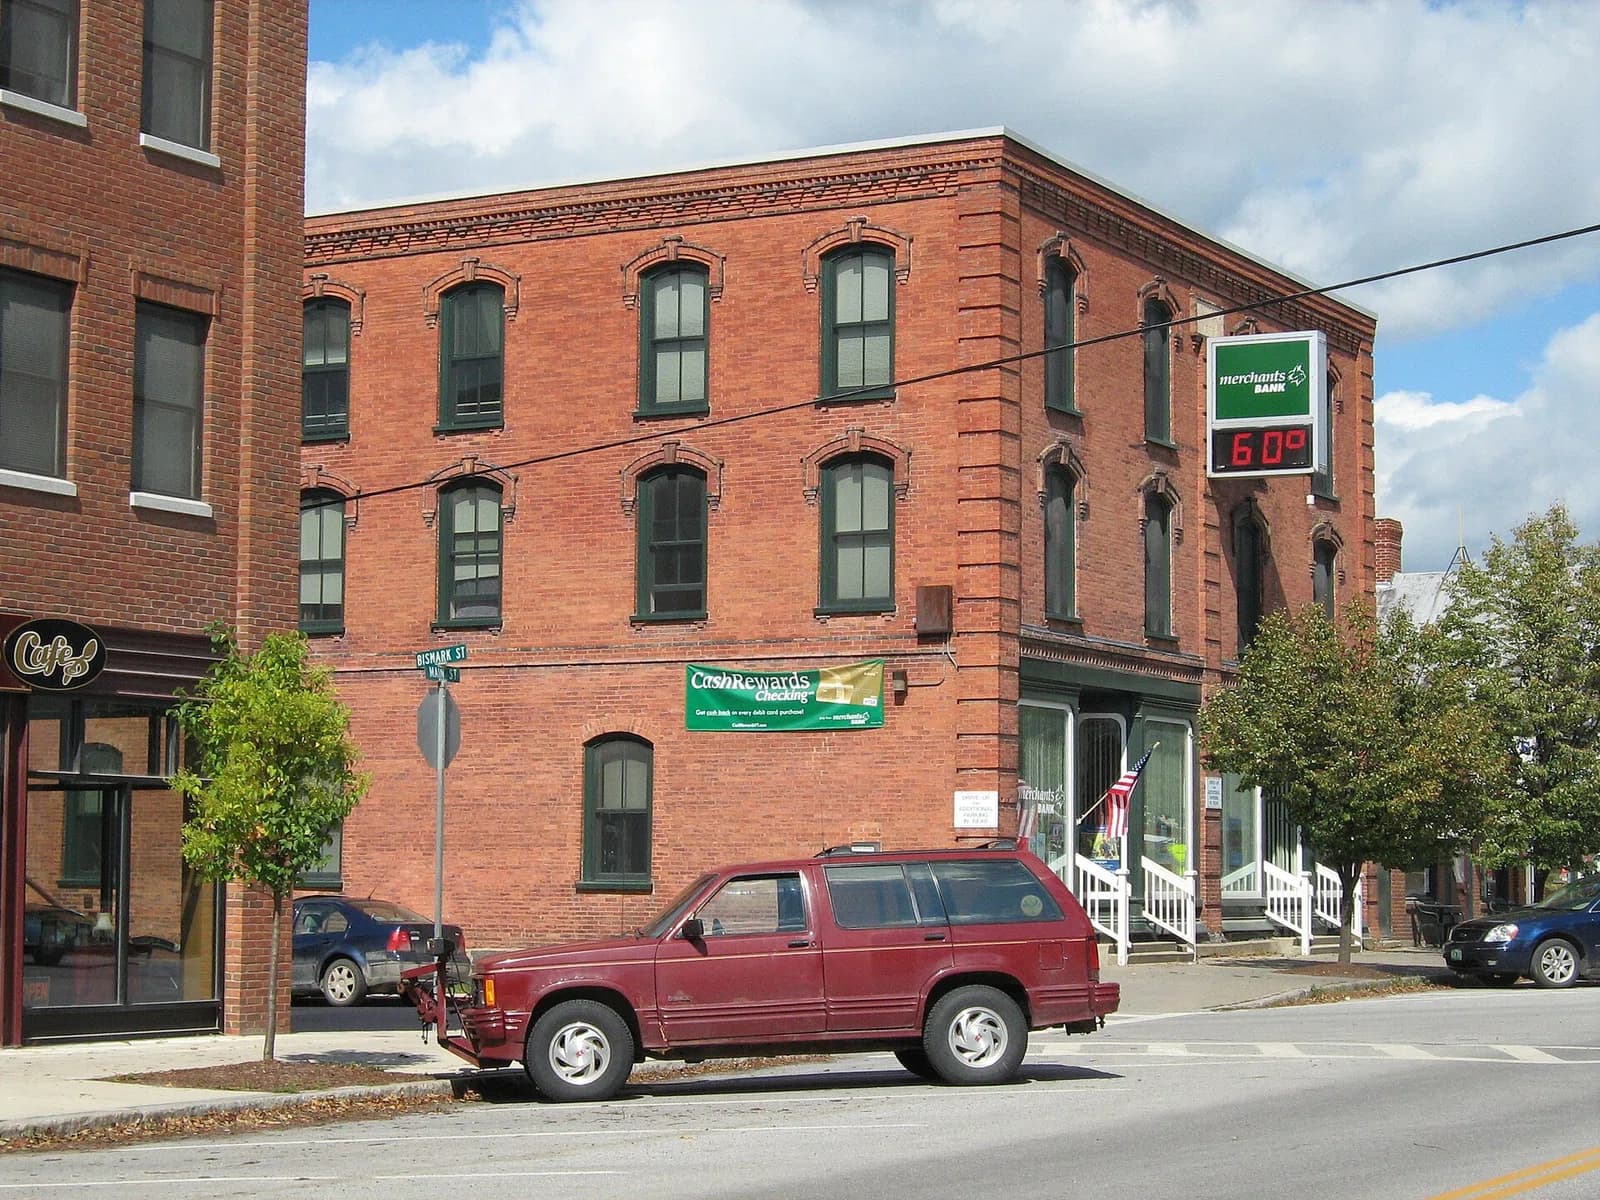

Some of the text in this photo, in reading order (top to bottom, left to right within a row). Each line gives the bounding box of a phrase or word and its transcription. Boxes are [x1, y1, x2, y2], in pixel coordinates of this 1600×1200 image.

[1219, 370, 1286, 386] merchants
[1254, 383, 1286, 394] BANK
[417, 646, 465, 666] BISMARK ST
[448, 669, 457, 680] ST
[691, 671, 810, 690] CashRewards
[755, 690, 809, 704] Checking
[1038, 803, 1055, 815] BANK
